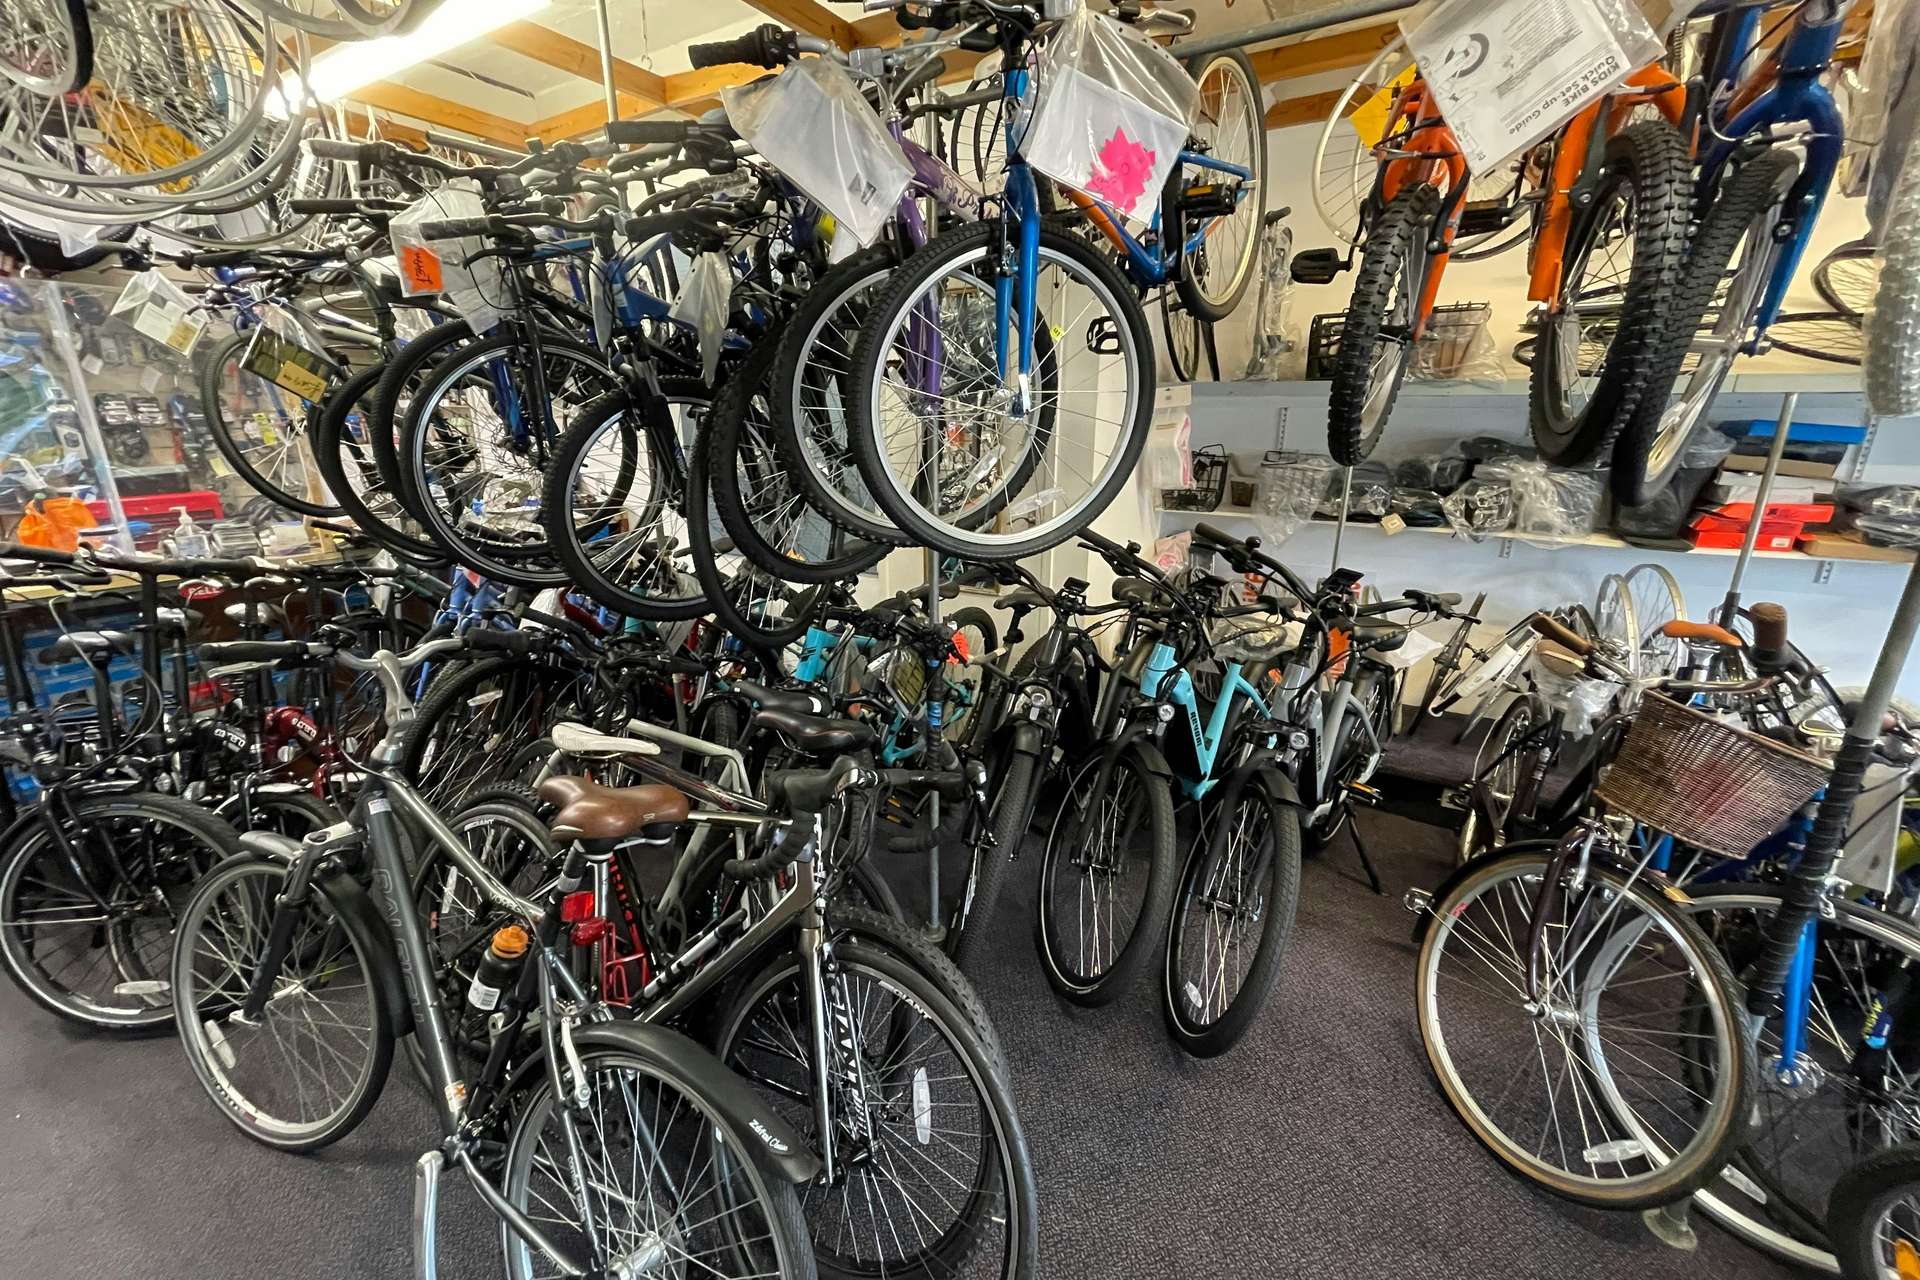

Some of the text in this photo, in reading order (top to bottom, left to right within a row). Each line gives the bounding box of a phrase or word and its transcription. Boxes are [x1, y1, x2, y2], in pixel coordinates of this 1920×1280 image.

[1509, 55, 1616, 135] Quick Set-up Guide
[1563, 62, 1620, 105] KIDS BIKE
[892, 988, 932, 1020] GIANT
